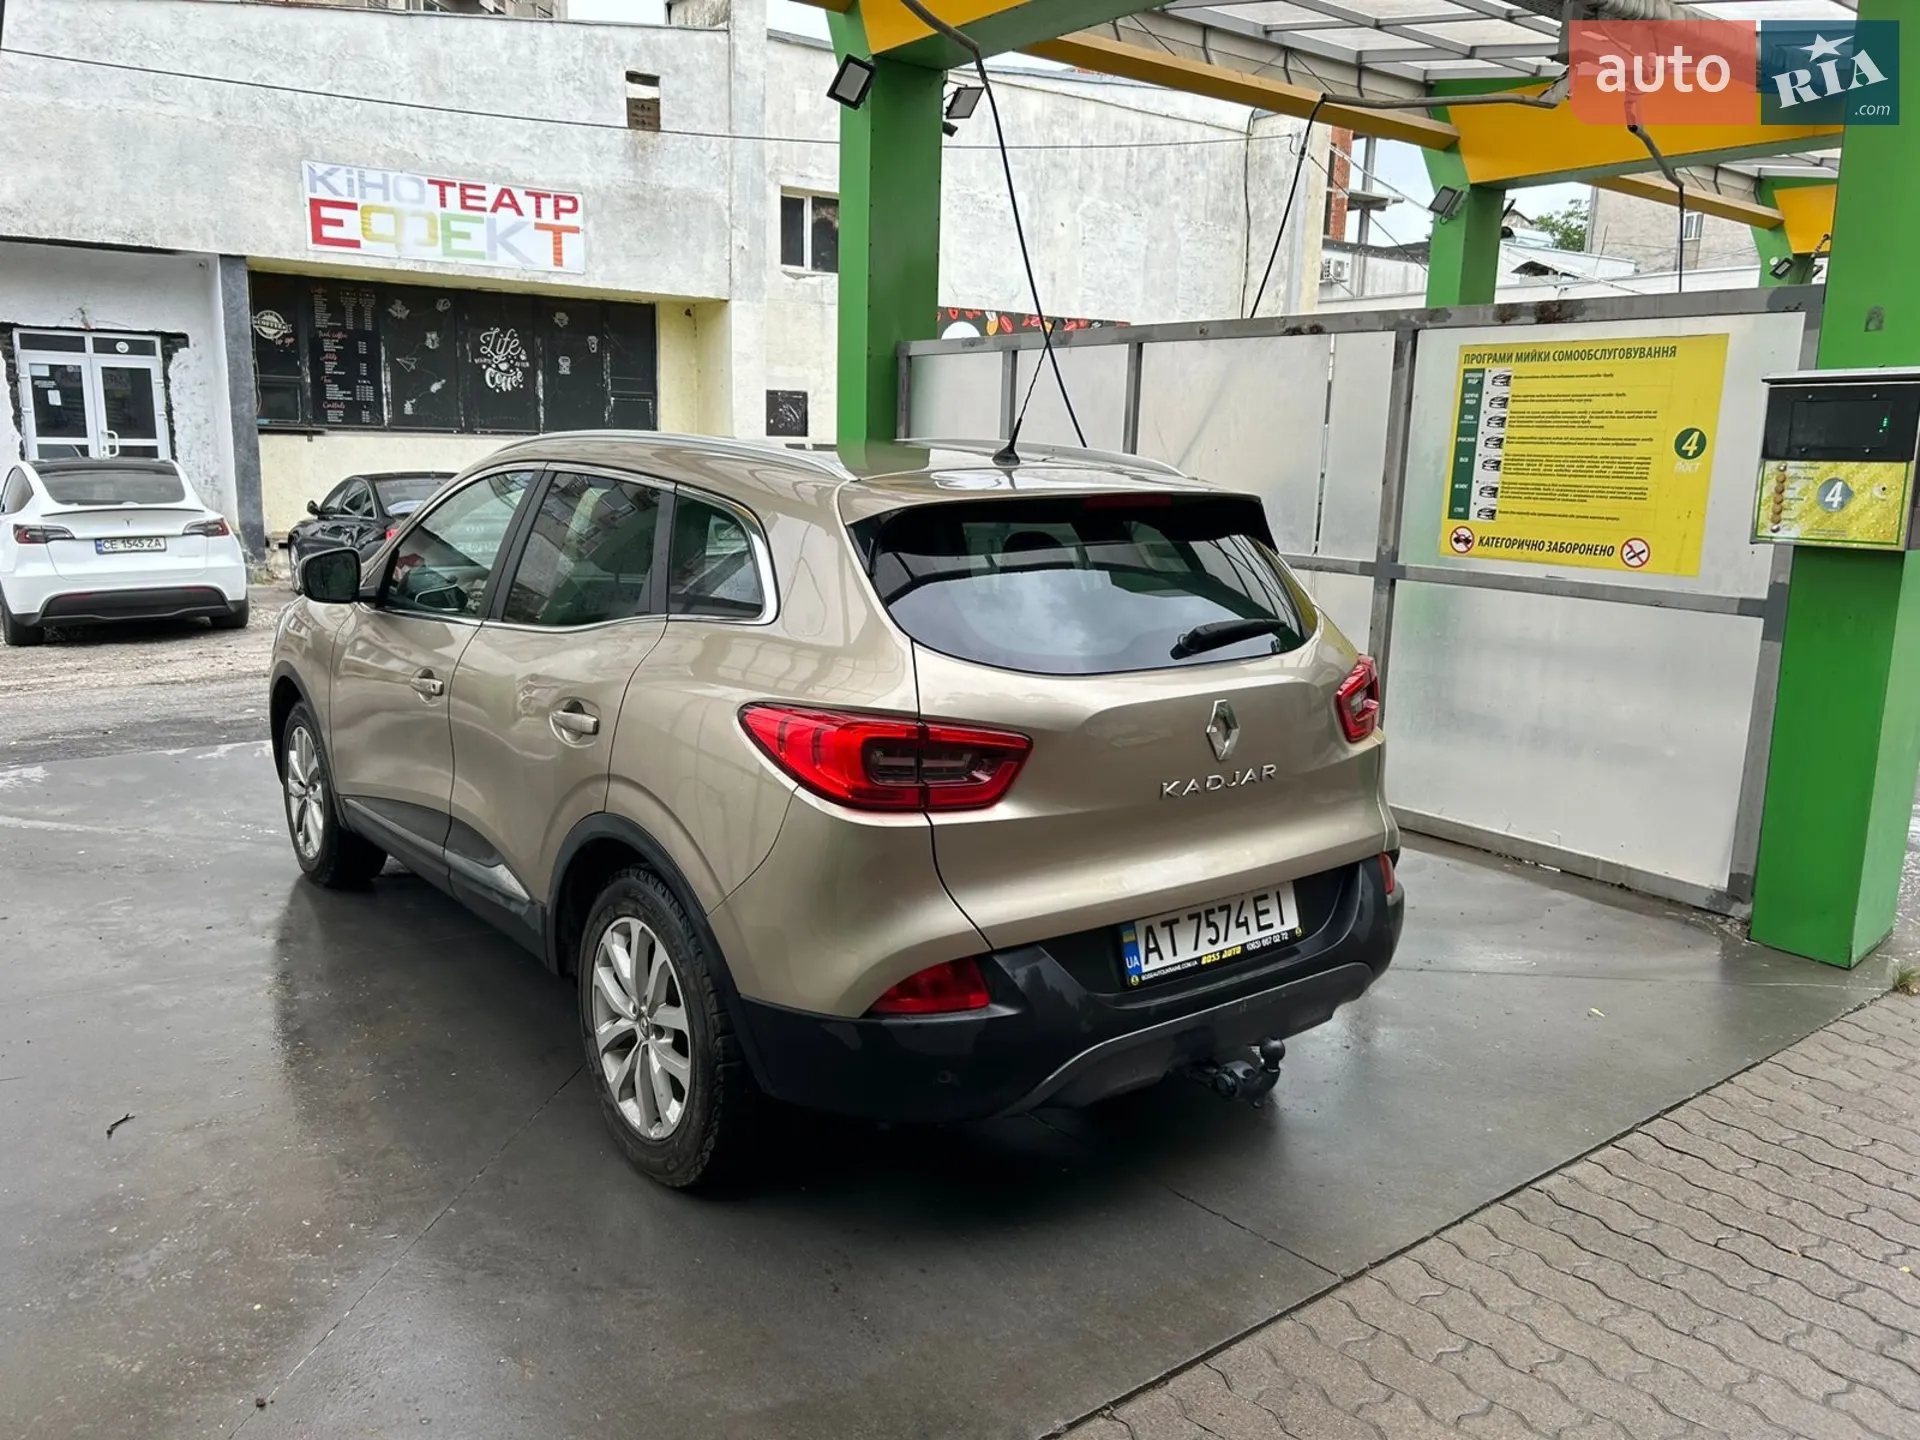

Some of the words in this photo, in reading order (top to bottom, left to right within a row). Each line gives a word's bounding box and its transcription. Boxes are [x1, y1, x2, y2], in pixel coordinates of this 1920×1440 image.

[309, 198, 580, 267] ЕФЕКТ
[480, 327, 522, 364] Life
[1463, 353, 1513, 365] ПРОГРАМИ
[1515, 349, 1551, 363] МИЙКИ
[1682, 431, 1700, 457] 4
[1824, 481, 1844, 508] 4
[103, 539, 118, 550] CE
[121, 539, 145, 549] 1545
[147, 538, 162, 548] ZA
[1477, 535, 1545, 552] КАТЕГОРИЧНО
[1547, 541, 1615, 557] ЗАБОРОНЕНО
[1160, 763, 1277, 799] KADJAR
[1144, 917, 1180, 965] AT
[1187, 900, 1250, 951] 7574
[1253, 890, 1285, 932] EI
[1126, 955, 1140, 969] UA
